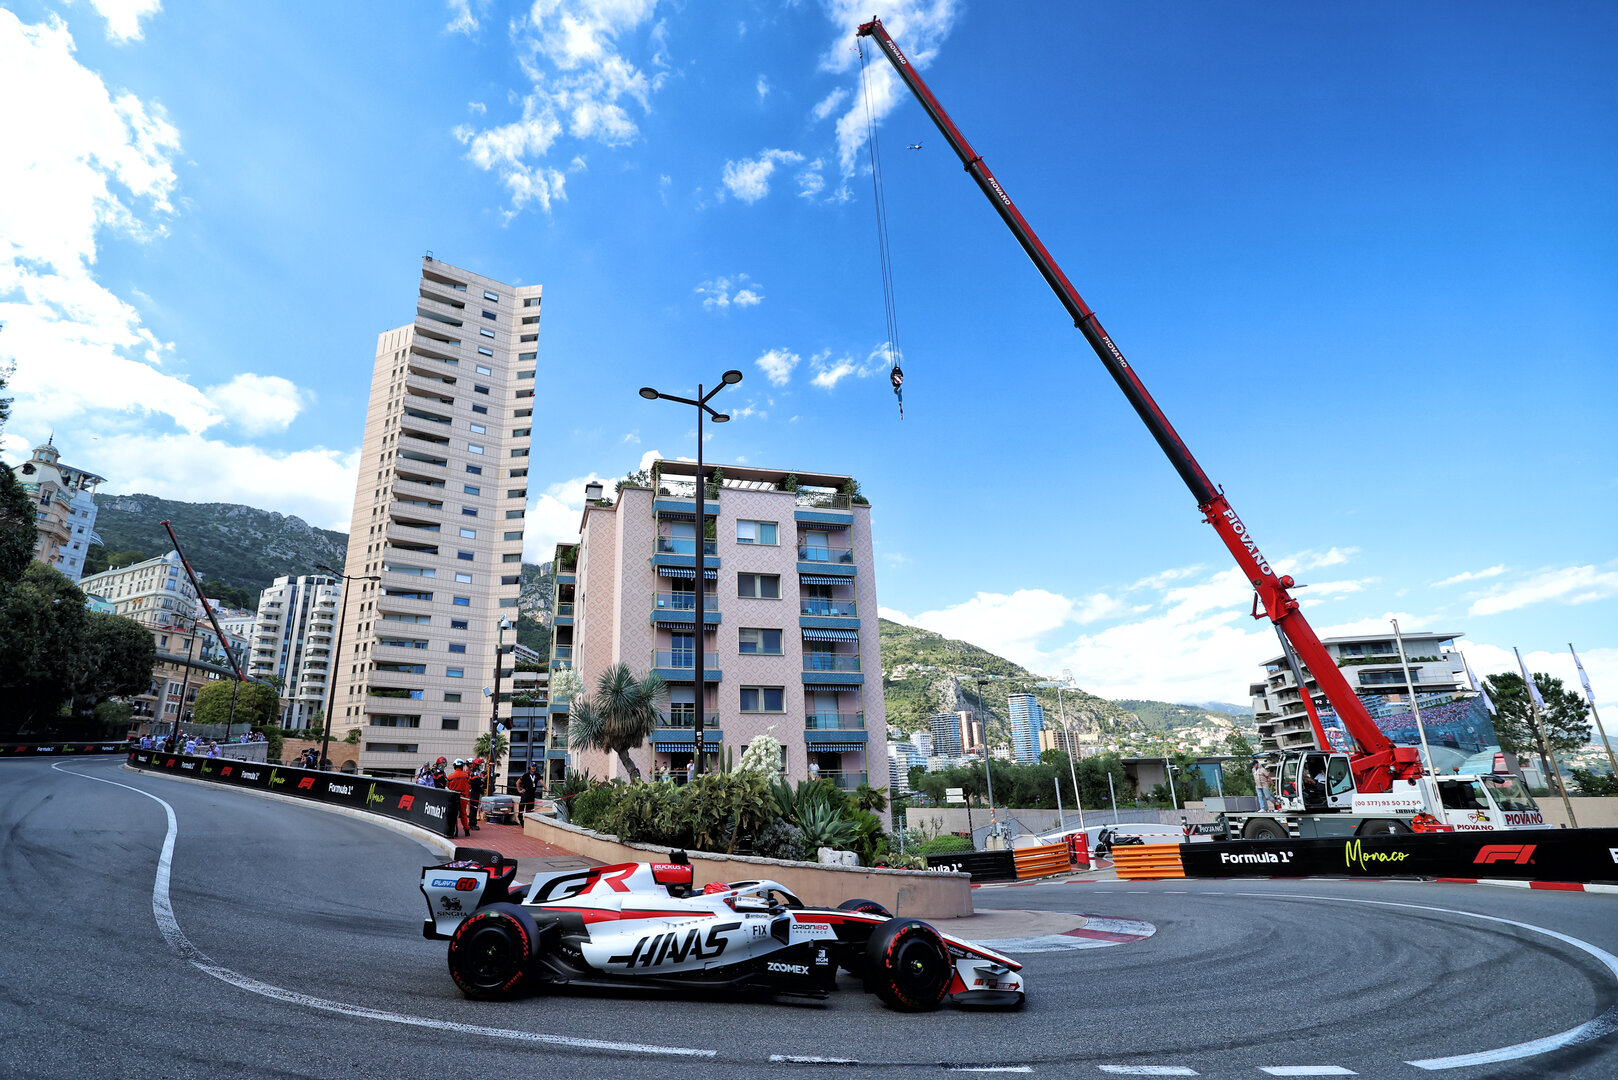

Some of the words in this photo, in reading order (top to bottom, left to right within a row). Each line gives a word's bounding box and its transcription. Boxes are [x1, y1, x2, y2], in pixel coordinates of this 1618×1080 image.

[886, 40, 907, 65] PIOVANO
[988, 177, 1011, 205] PIOVANO
[1102, 336, 1128, 368] PIOVANO
[1222, 508, 1273, 576] PIOVANO
[328, 782, 347, 795] Formula
[424, 802, 441, 818] Formula
[1504, 812, 1543, 825] PIOVANO
[1221, 851, 1278, 863] Formula
[1345, 838, 1410, 871] Monaco
[456, 878, 478, 891] GO
[752, 924, 768, 936] FIX
[607, 921, 743, 969] HAAS
[767, 961, 809, 975] ZOOMEX
